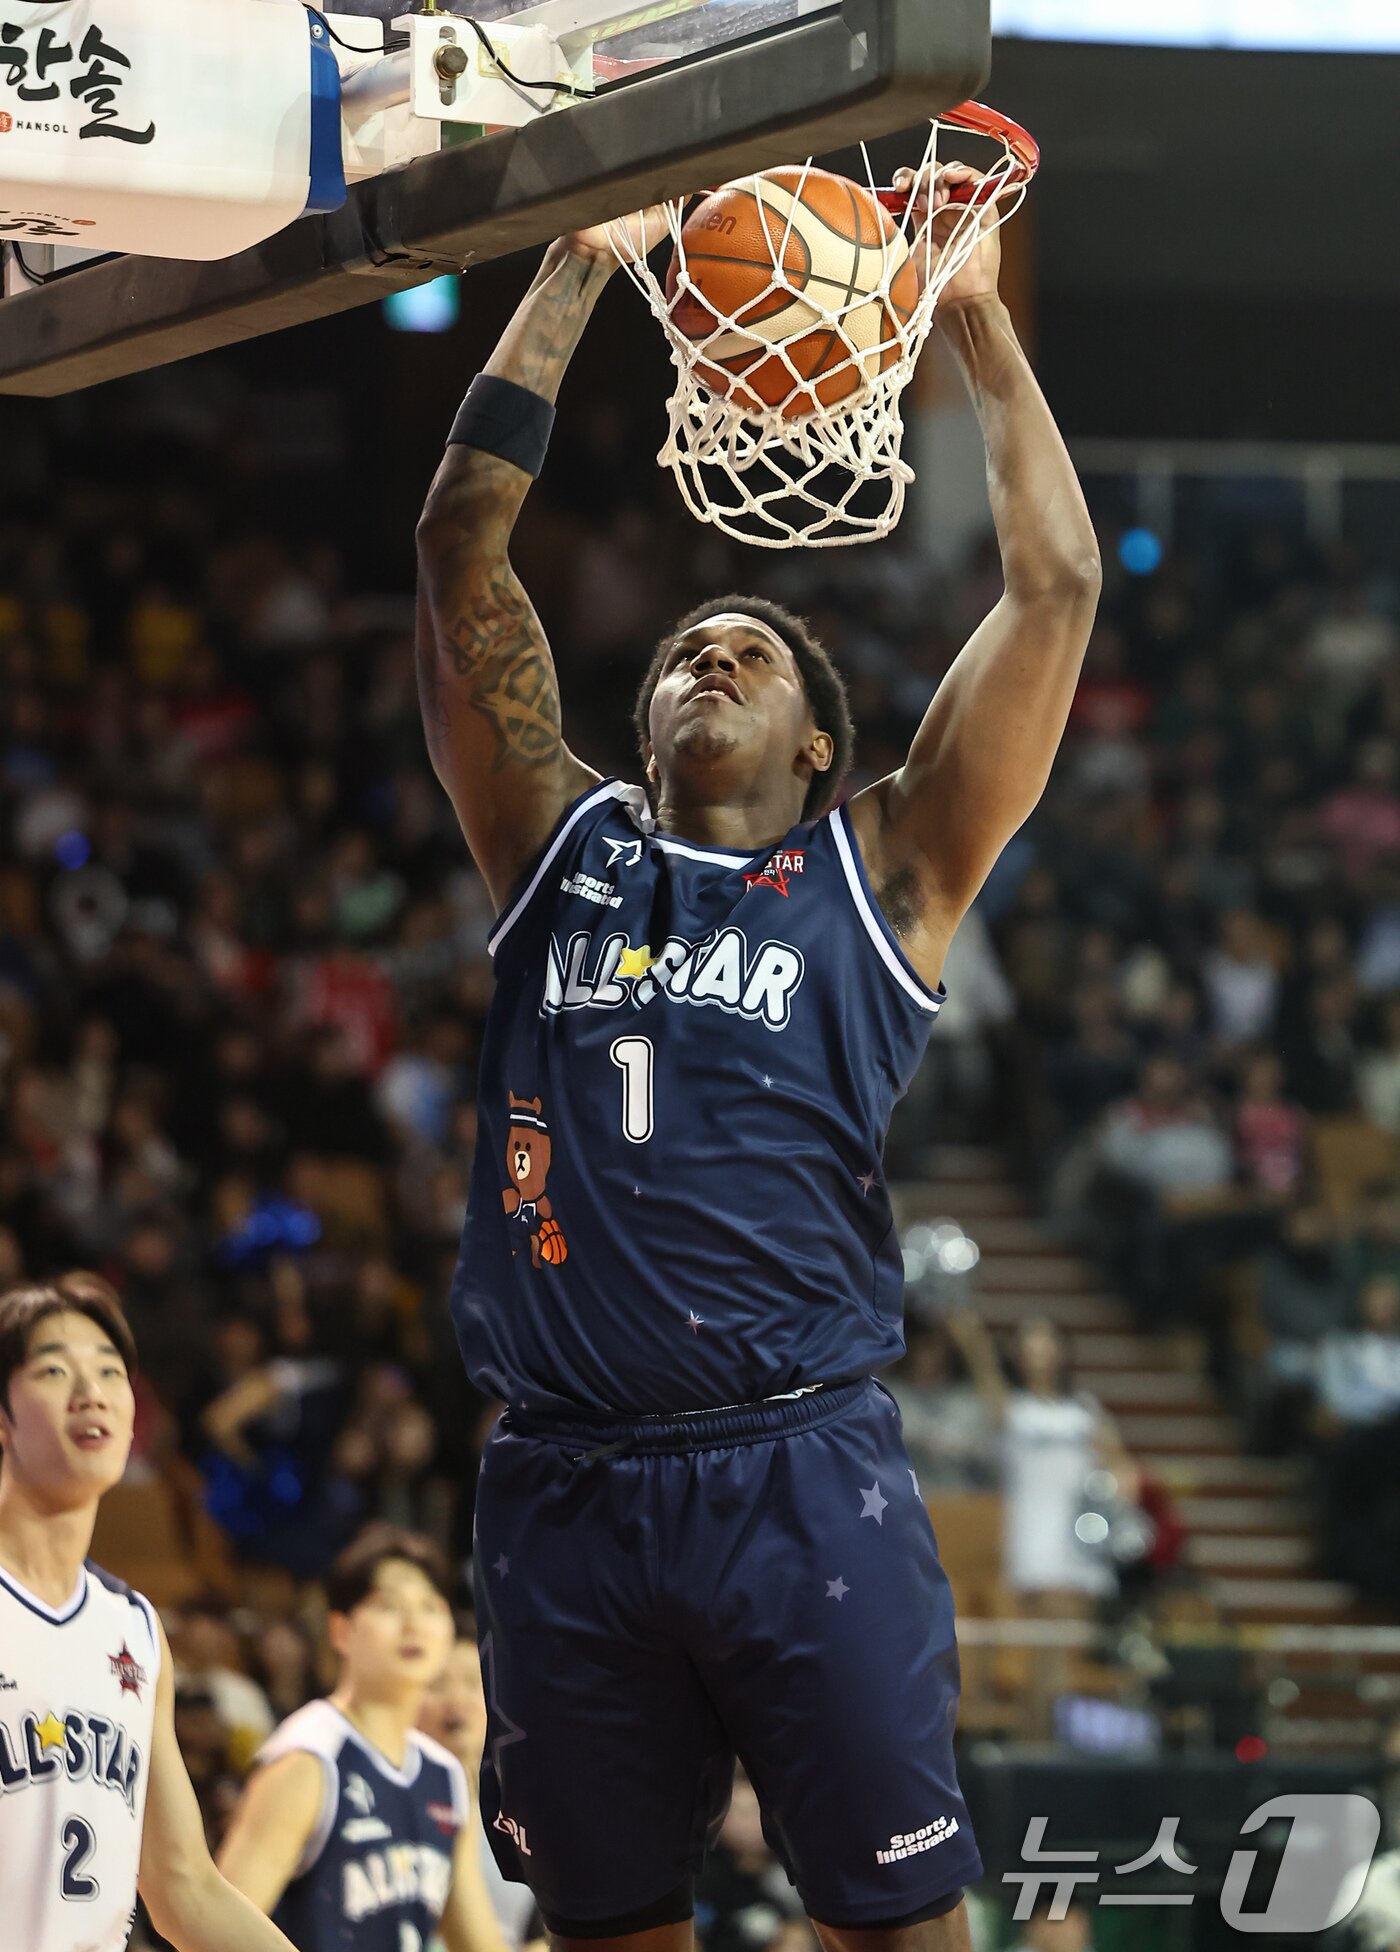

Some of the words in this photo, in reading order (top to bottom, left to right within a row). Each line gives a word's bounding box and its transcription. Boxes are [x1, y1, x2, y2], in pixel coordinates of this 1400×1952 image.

[0, 22, 156, 145] 한솔
[16, 120, 69, 133] HANSOL
[609, 1035, 654, 1145] 1
[60, 1814, 100, 1901] 2
[876, 1816, 960, 1864] Illustrated
[890, 1815, 947, 1849] Sports
